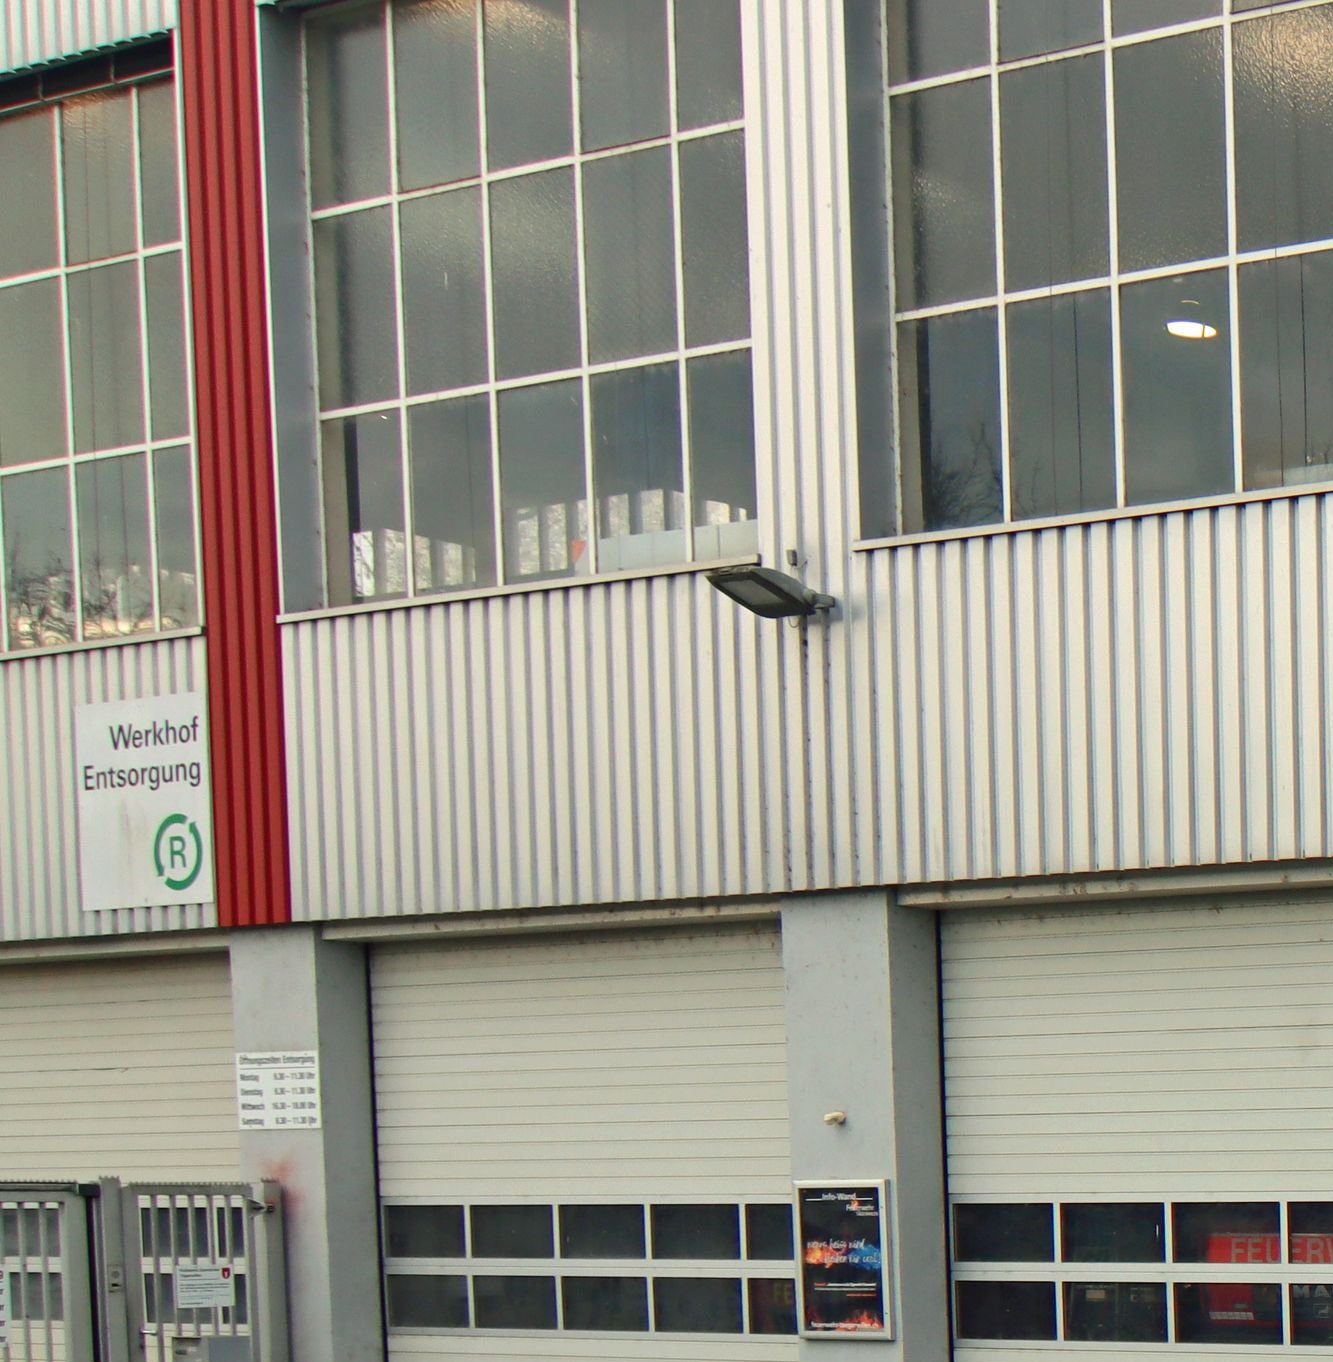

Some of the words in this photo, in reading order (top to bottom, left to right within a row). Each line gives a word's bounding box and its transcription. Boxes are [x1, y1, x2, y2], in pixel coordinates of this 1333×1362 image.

[108, 715, 199, 750] Werkhof
[83, 762, 201, 791] Entsorgung
[169, 836, 187, 869] R
